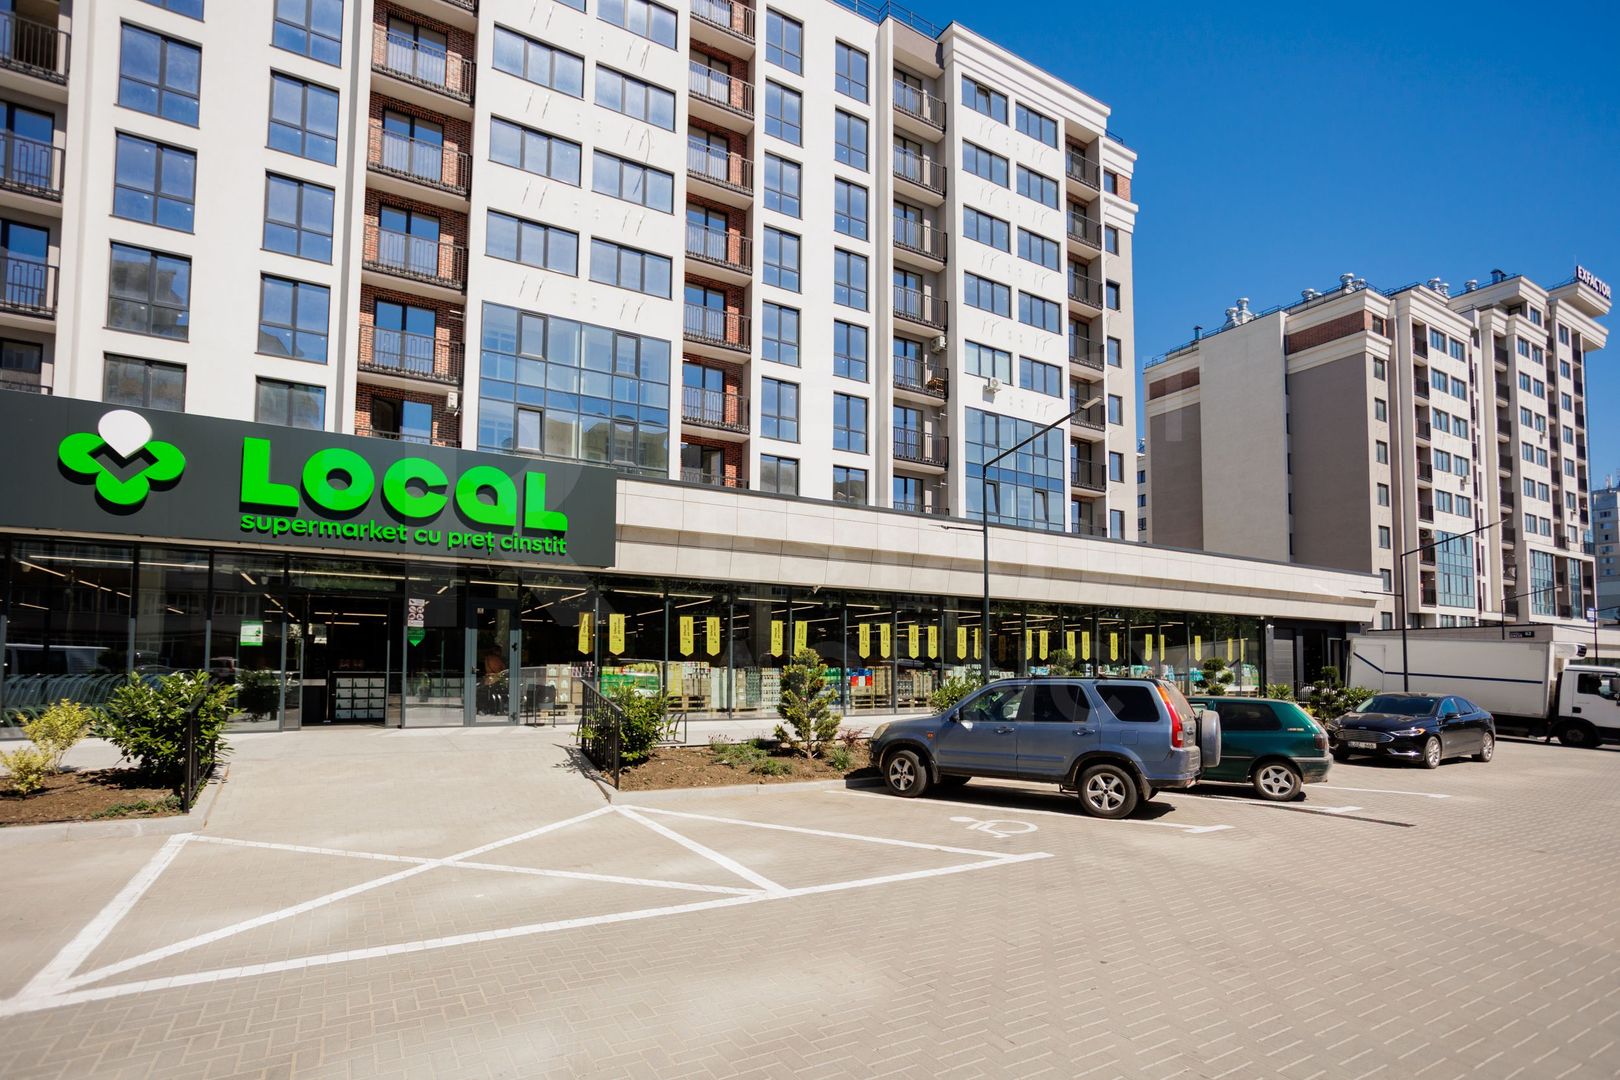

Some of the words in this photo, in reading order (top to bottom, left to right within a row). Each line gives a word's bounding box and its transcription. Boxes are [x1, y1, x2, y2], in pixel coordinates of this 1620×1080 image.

[240, 513, 407, 541] supermarket
[415, 526, 441, 544] cu
[448, 529, 495, 555] preț
[500, 533, 568, 553] cinstit
